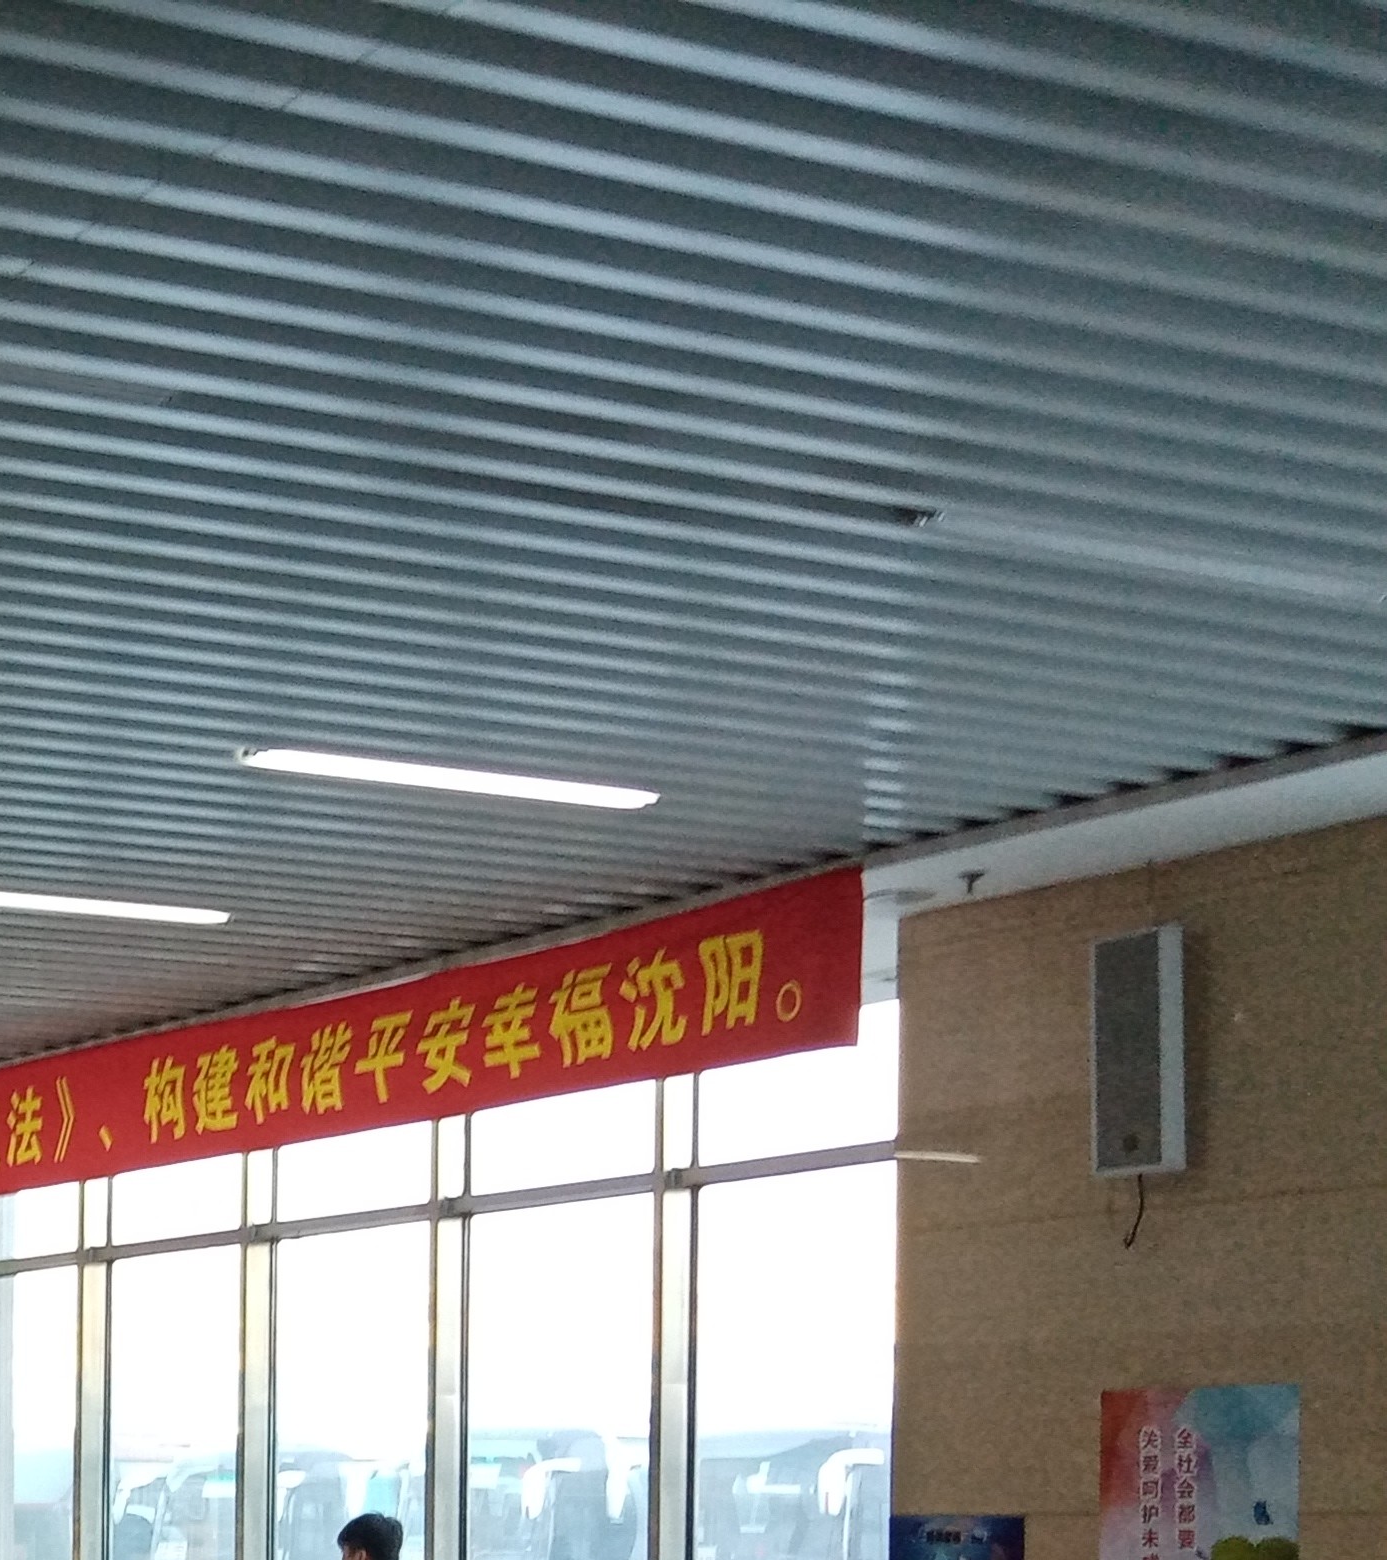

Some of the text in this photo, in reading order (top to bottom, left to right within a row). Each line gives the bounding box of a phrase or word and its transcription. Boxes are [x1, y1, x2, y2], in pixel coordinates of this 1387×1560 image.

[1175, 1427, 1197, 1551] 全社会都要
